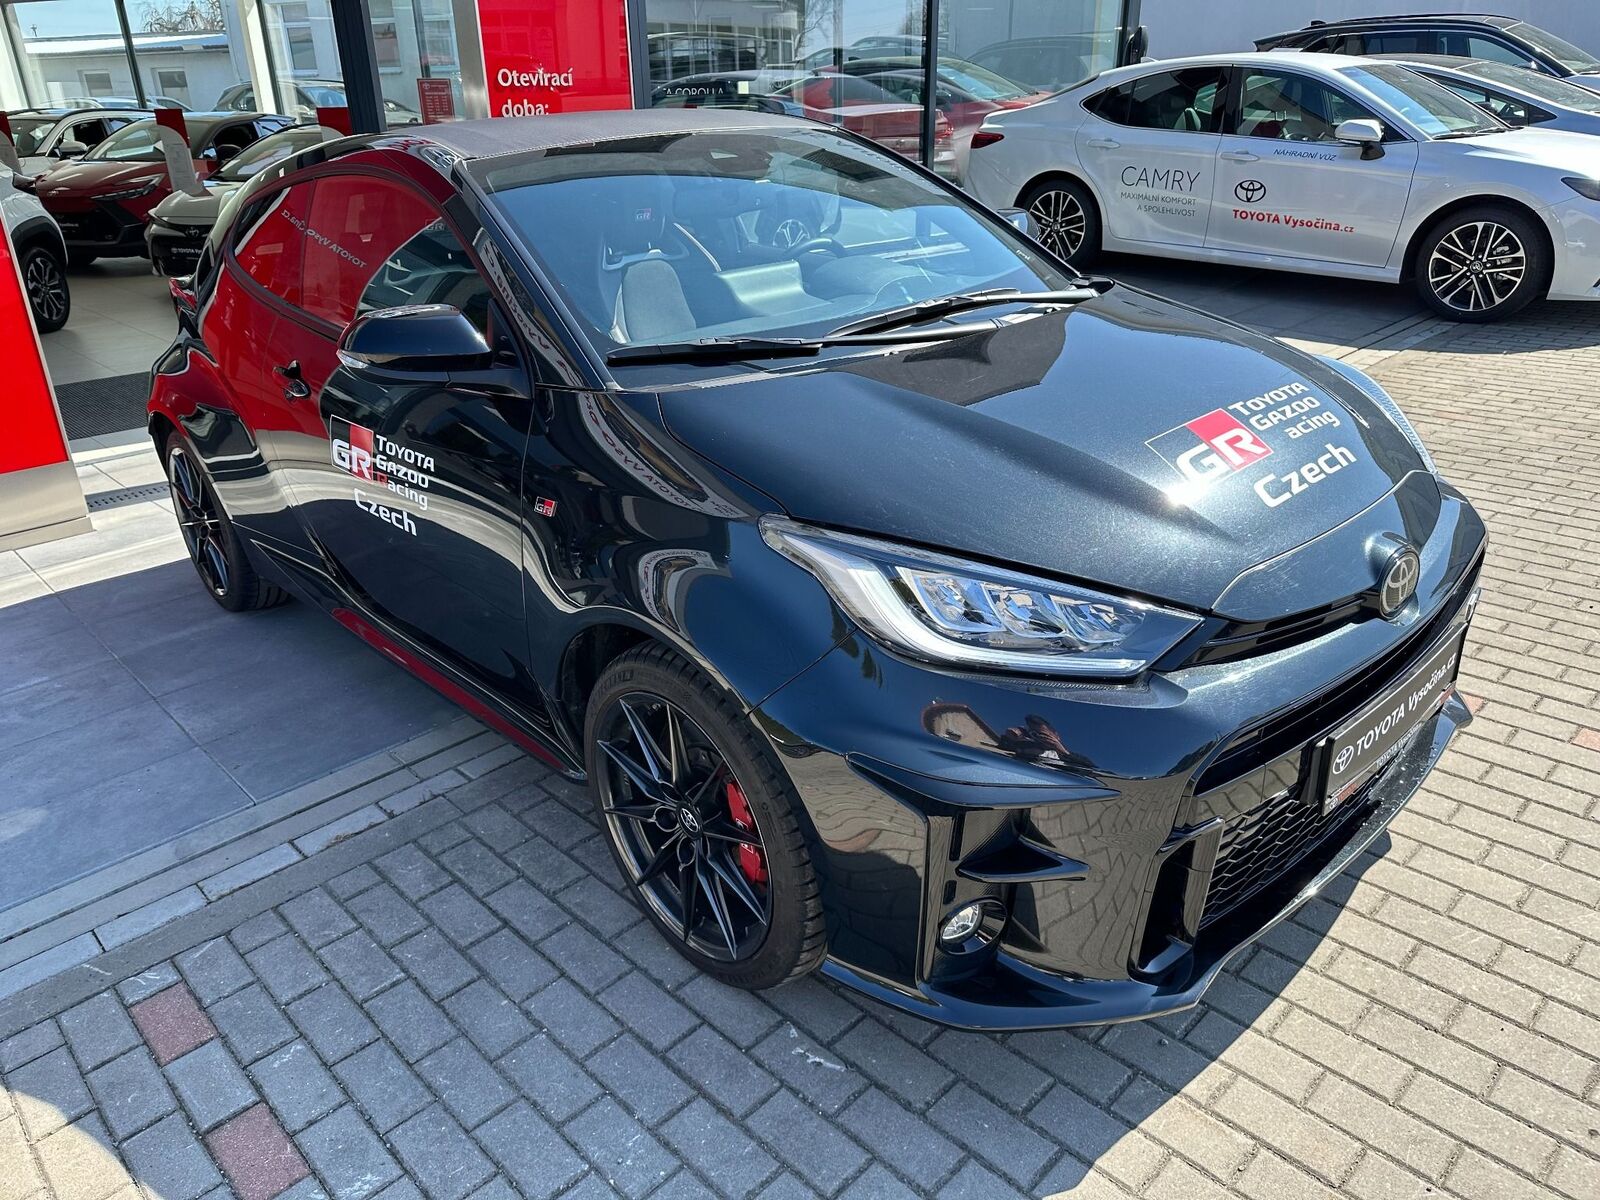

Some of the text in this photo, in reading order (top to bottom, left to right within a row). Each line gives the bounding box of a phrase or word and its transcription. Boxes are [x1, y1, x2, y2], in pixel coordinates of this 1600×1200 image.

[501, 98, 549, 118] doba:
[1121, 166, 1201, 192] CAMRY
[1120, 191, 1197, 206] MAXIMÁLNÍ KOMFORT
[1143, 204, 1196, 217] SPOLEHLIVOST
[1233, 209, 1355, 233] TOYOTA Vysočina.cz
[1227, 381, 1310, 417] TOYOTA
[1249, 396, 1321, 432] GAZOO
[1284, 410, 1341, 440] acing
[332, 438, 372, 480] GR
[376, 434, 435, 473] TOYOTA
[1176, 427, 1268, 480] GR
[376, 454, 429, 489] GAZOO
[1252, 442, 1358, 509] Czech
[354, 488, 417, 537] Czech
[536, 503, 551, 515] GR
[1356, 702, 1405, 756] TOYOTA
